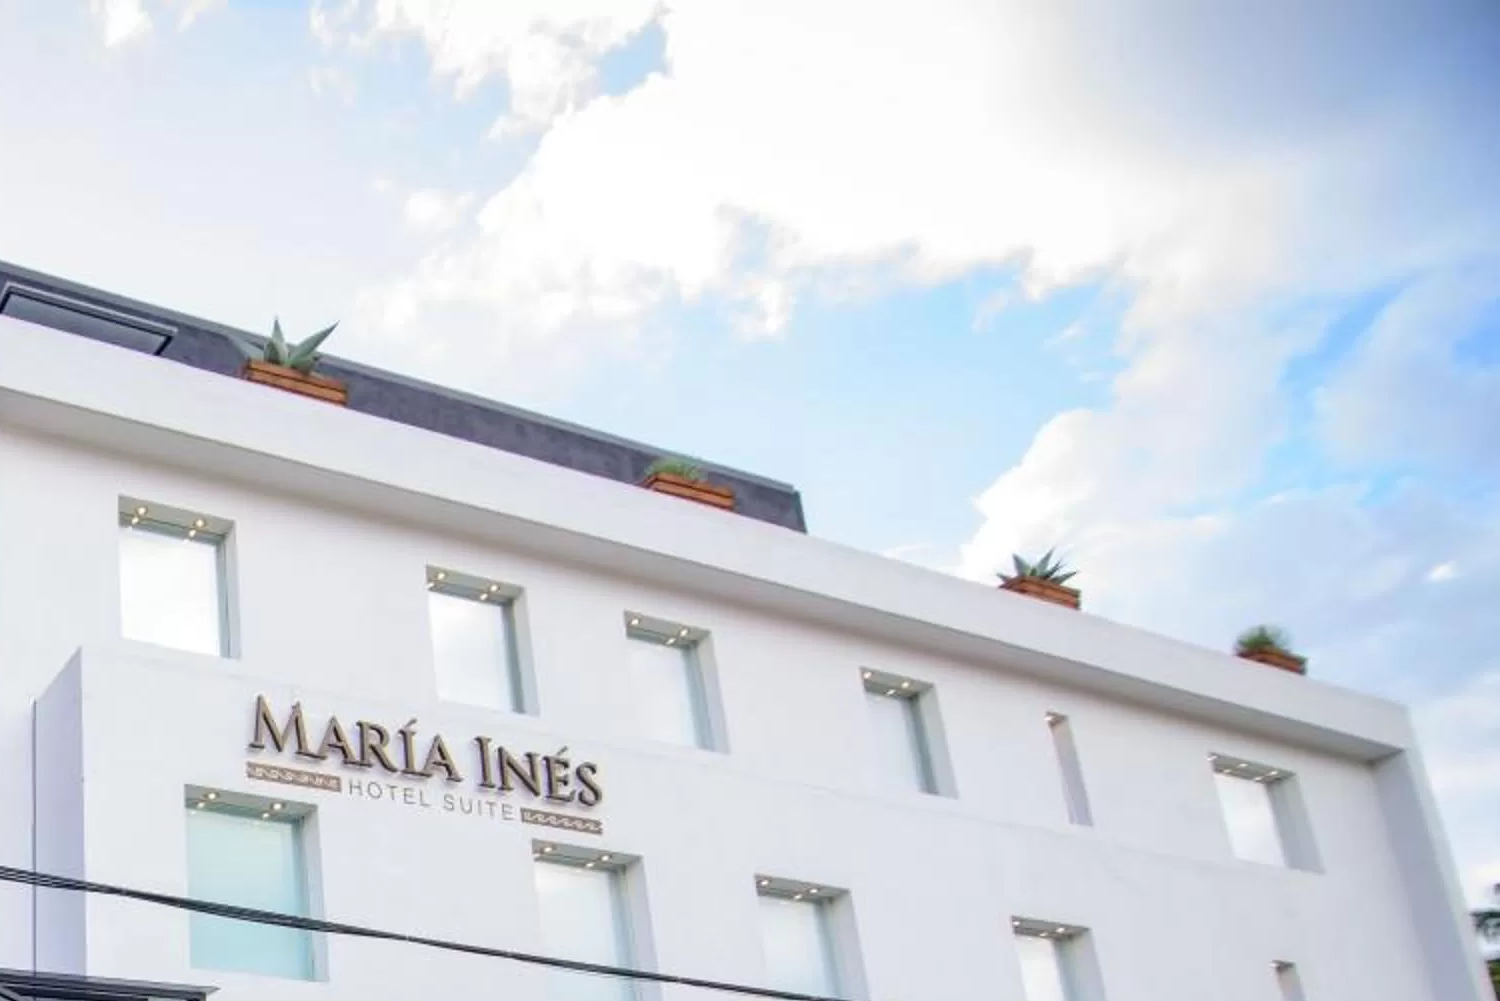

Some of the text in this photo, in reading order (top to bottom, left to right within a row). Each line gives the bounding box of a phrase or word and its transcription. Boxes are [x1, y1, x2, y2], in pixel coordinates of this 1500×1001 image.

[247, 694, 604, 807] MARÍA INÉS
[348, 779, 515, 822] HOTEL SUITE
